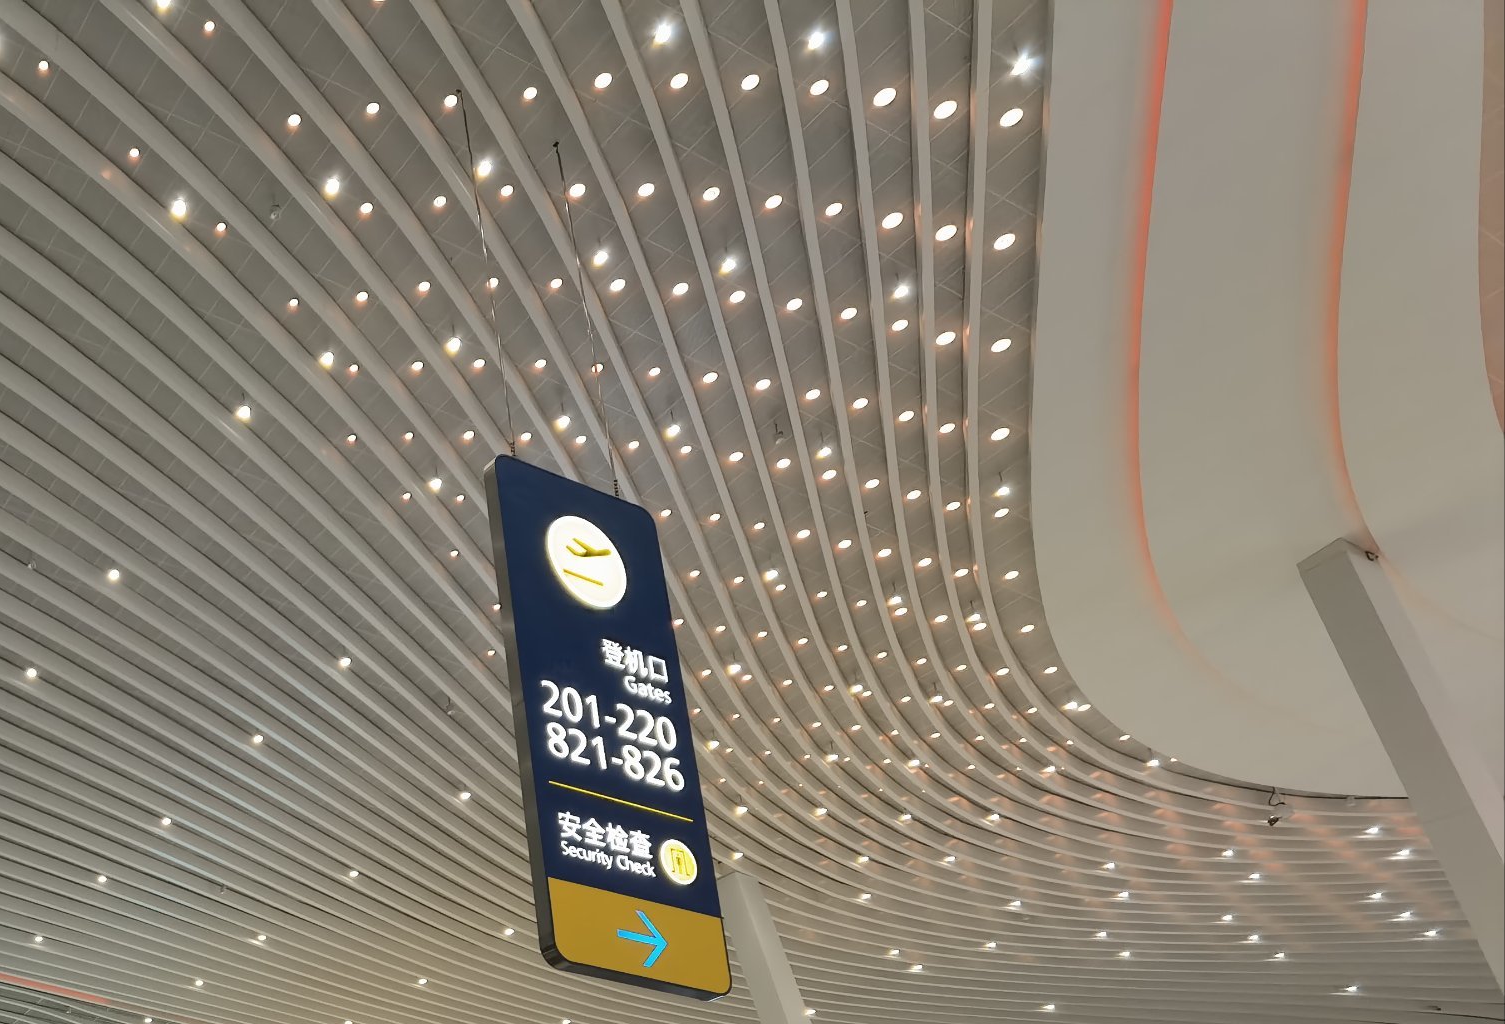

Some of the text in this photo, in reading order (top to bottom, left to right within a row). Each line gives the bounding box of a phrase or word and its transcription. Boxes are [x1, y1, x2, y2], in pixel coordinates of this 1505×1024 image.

[601, 639, 669, 683] 登机口
[624, 675, 672, 704] Gates
[541, 679, 677, 751] 201-220
[546, 721, 685, 792] 821-826
[558, 811, 653, 860] 安全检查
[560, 840, 656, 879] Security Check
